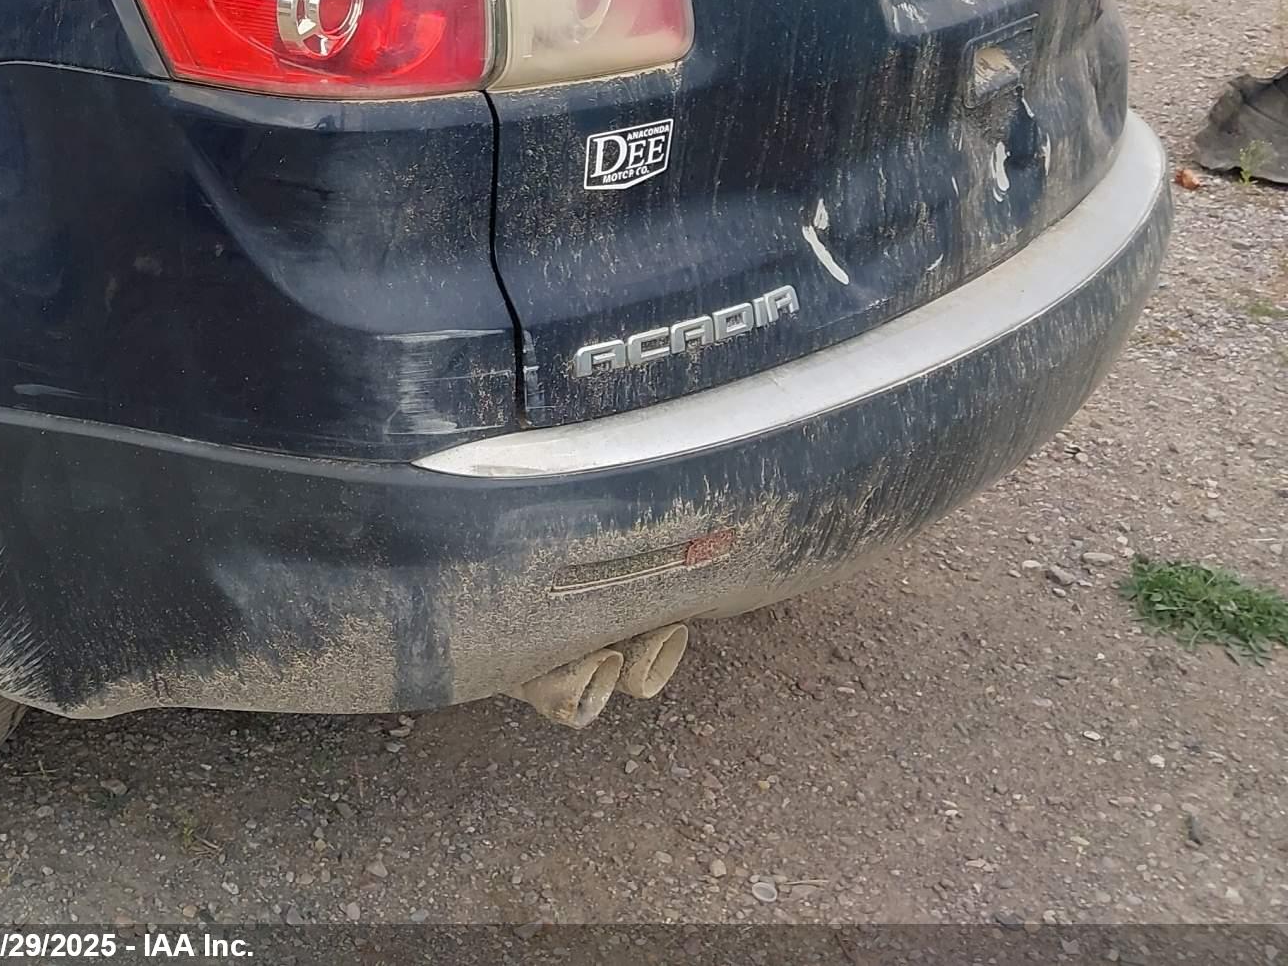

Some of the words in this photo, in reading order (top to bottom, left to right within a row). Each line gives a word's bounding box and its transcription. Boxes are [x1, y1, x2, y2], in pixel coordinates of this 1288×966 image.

[627, 124, 670, 141] ANACONDA
[590, 135, 666, 178] DEE
[602, 169, 634, 184] MOTOR
[635, 165, 650, 176] CO.
[574, 284, 800, 378] ACADIA
